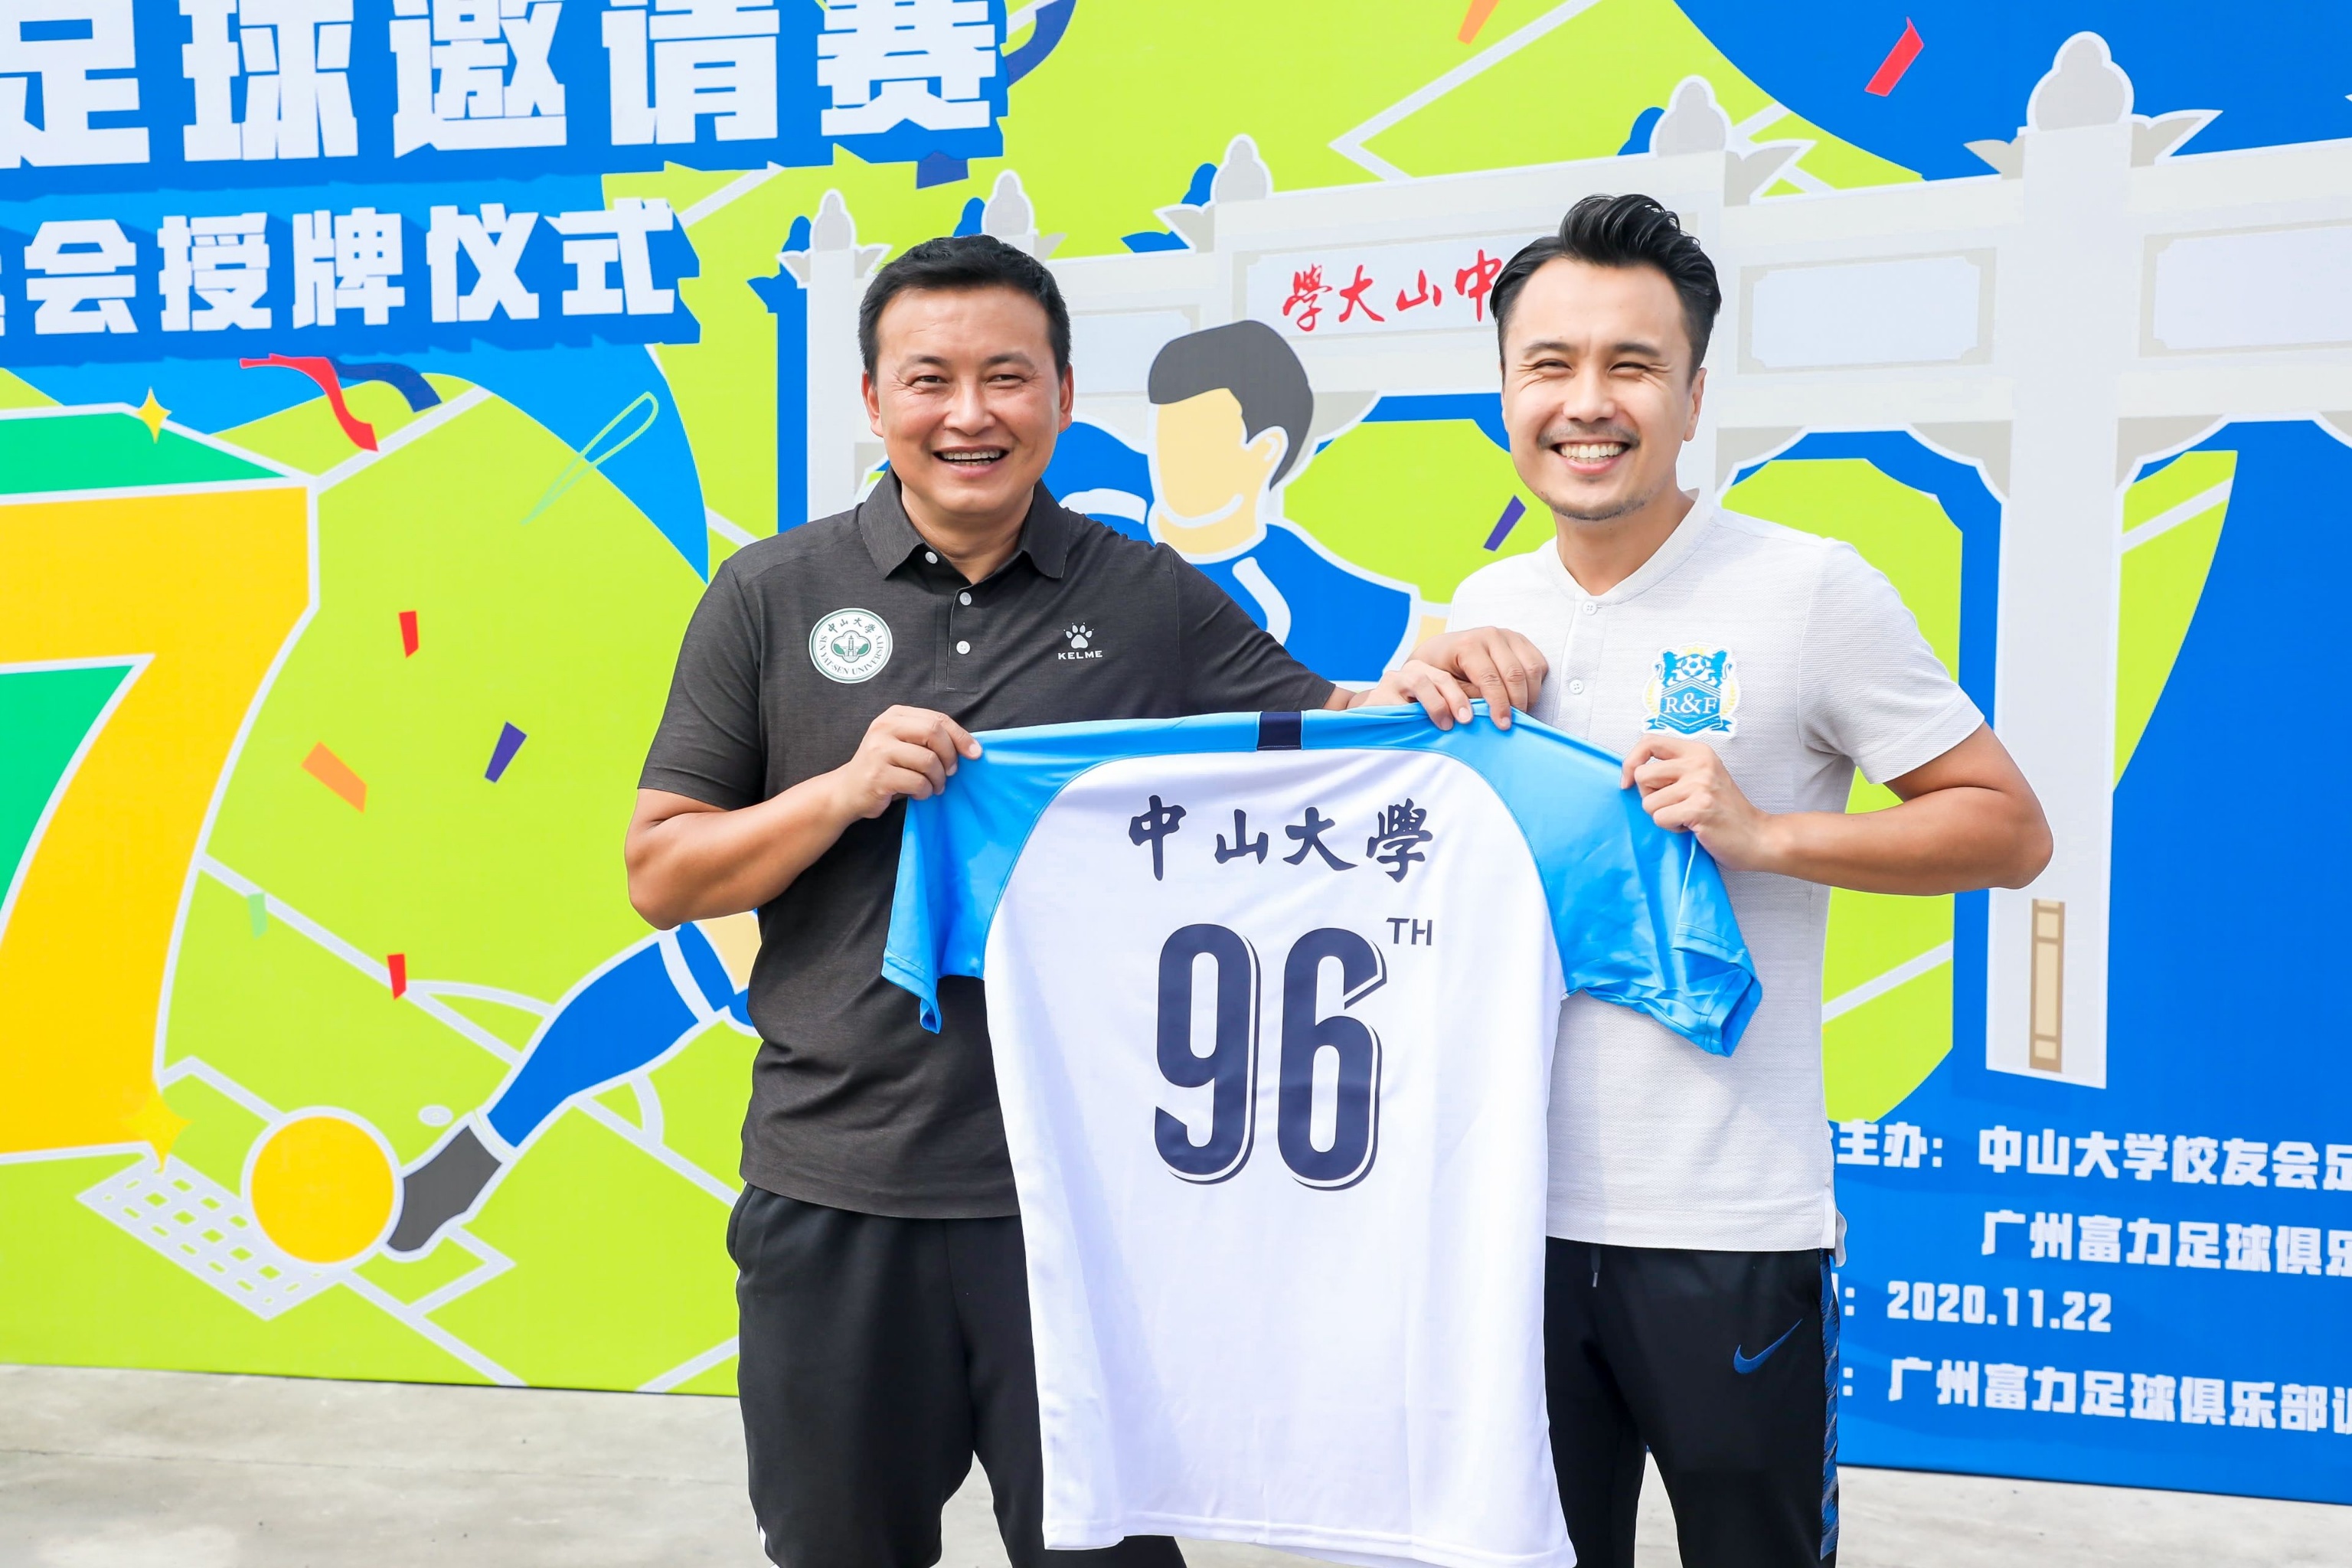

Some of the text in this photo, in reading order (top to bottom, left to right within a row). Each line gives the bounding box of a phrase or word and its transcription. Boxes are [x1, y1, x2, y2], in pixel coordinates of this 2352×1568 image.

[0, 0, 996, 168] 足球邀请赛
[0, 197, 675, 336] 会授牌仪式
[1058, 650, 1102, 660] KELME
[1664, 692, 1717, 714] R&F
[1129, 795, 1433, 883] 中山大學
[1154, 917, 1432, 1191] 96 TH
